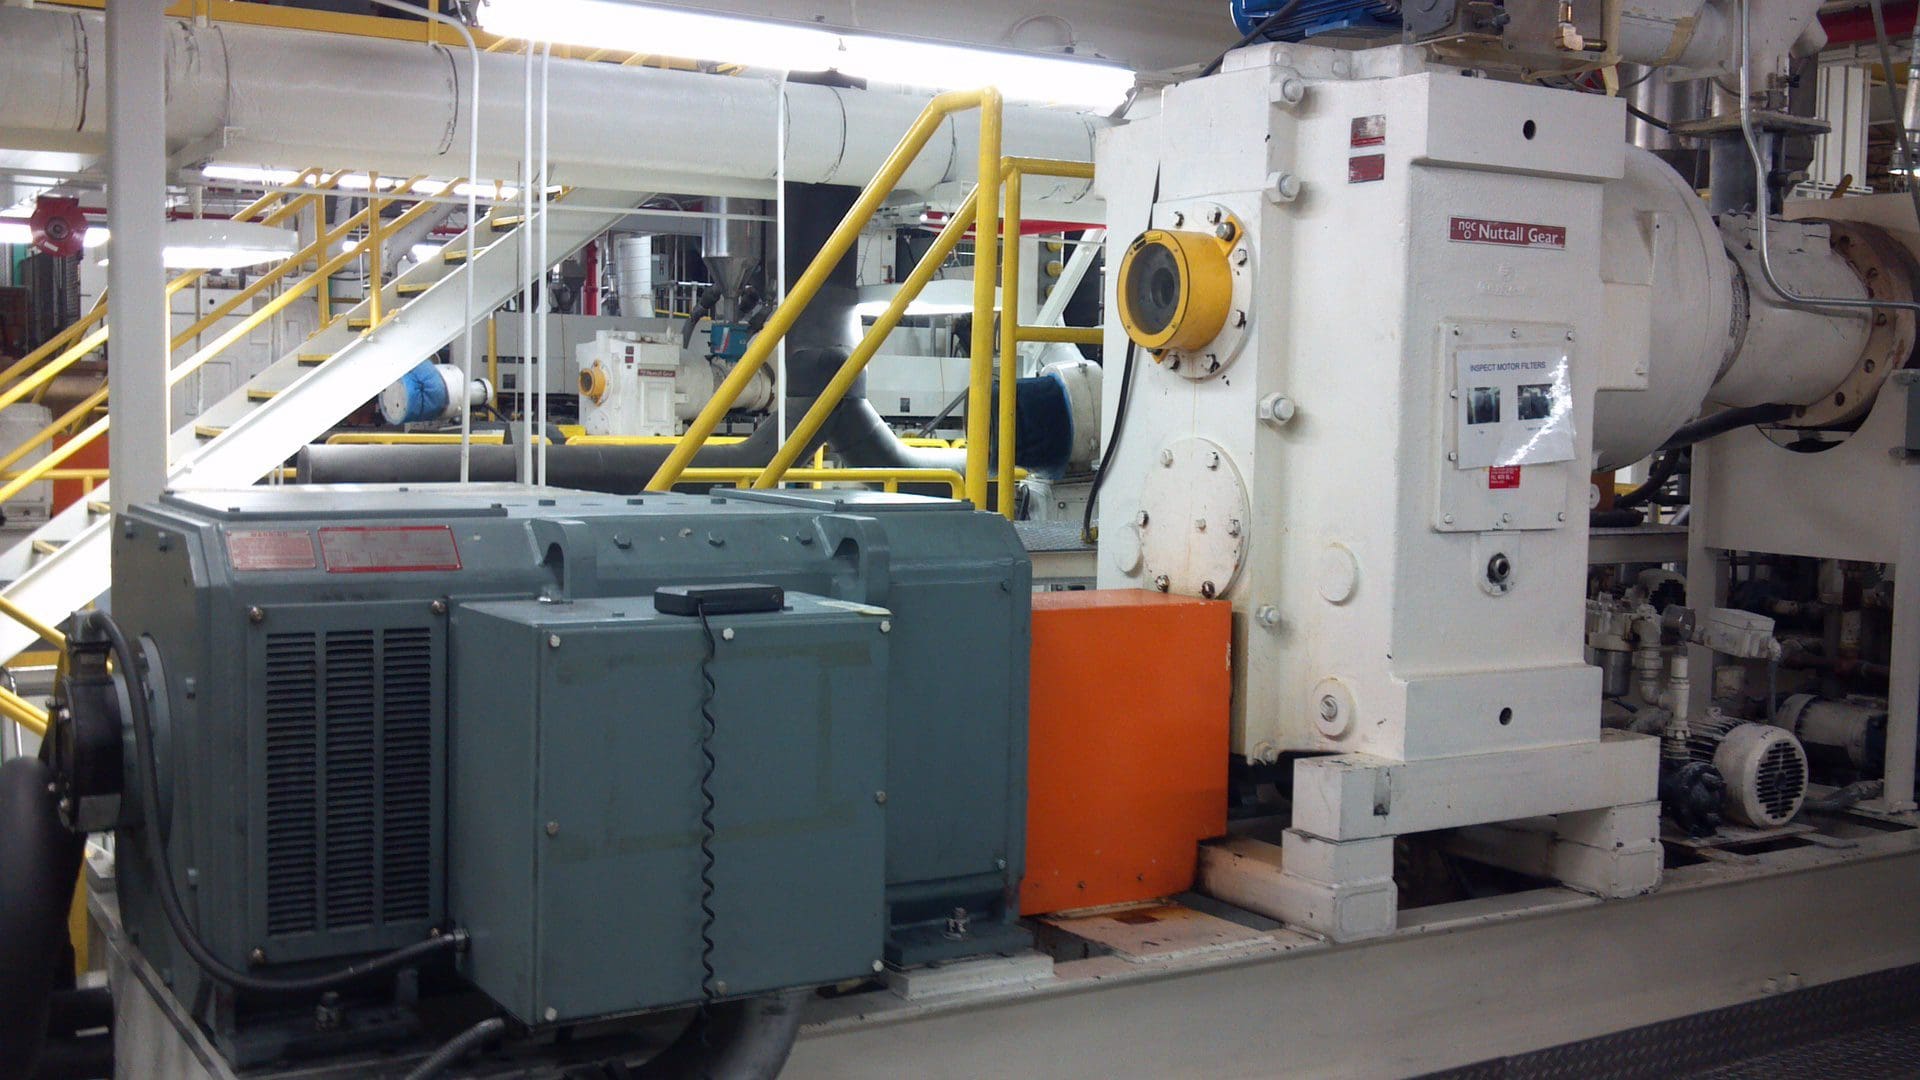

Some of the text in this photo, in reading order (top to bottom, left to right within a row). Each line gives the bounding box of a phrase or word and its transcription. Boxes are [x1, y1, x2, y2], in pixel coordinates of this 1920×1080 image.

[1479, 223, 1524, 241] Nuttall
[1528, 228, 1559, 243] Gear
[1470, 361, 1546, 372] INSPECT MOTOR FILTERS
